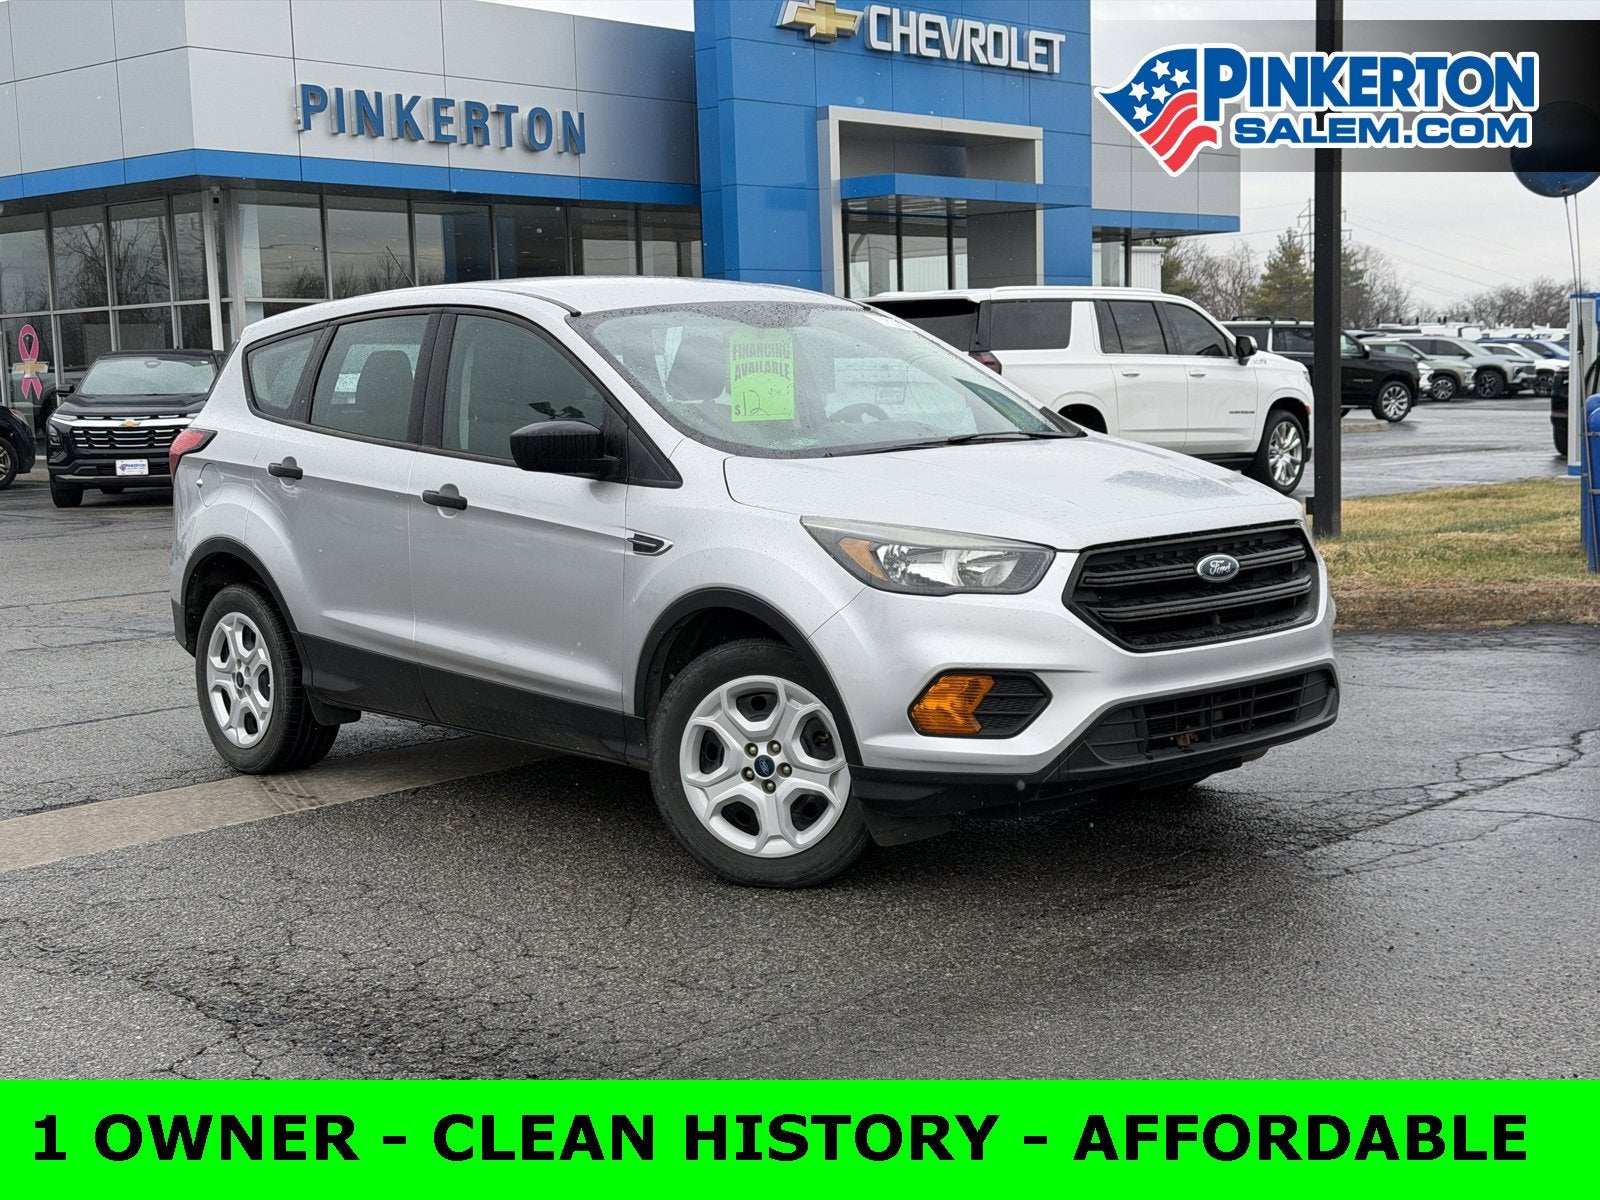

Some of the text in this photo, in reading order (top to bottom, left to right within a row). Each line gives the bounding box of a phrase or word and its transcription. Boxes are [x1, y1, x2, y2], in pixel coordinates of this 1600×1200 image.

[867, 5, 1066, 73] CHEVROLET
[300, 84, 587, 153] PINKERTON
[732, 343, 791, 361] FINANCING
[734, 360, 792, 382] AVAILABLE
[1210, 560, 1231, 575] Ford
